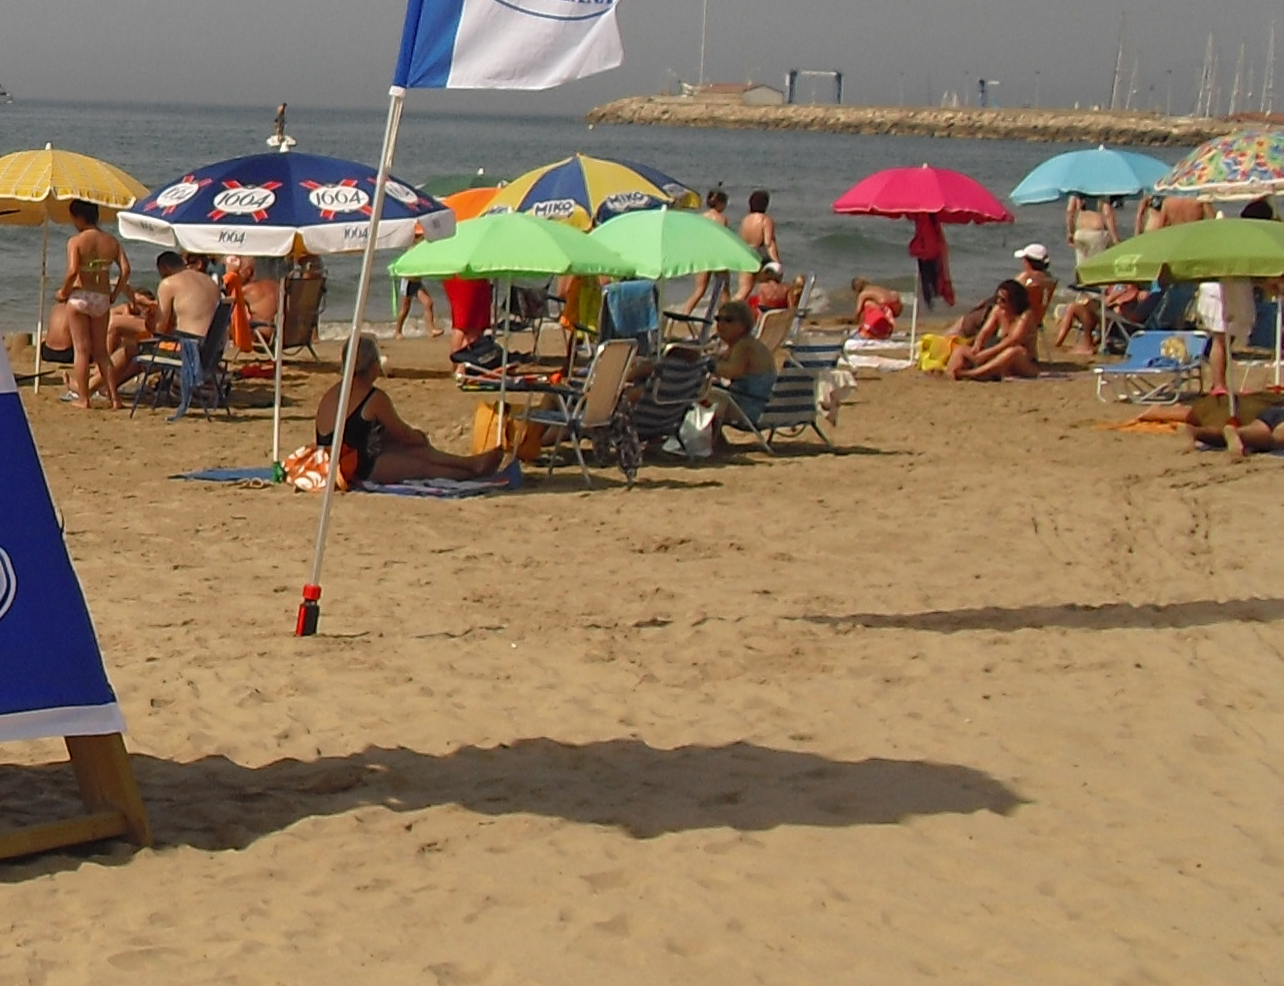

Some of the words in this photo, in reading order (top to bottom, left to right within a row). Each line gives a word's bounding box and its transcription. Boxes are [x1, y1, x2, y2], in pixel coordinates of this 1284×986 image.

[218, 190, 272, 212] 1664
[314, 189, 364, 206] 1664
[534, 202, 574, 217] MIKO
[217, 231, 246, 245] 1664
